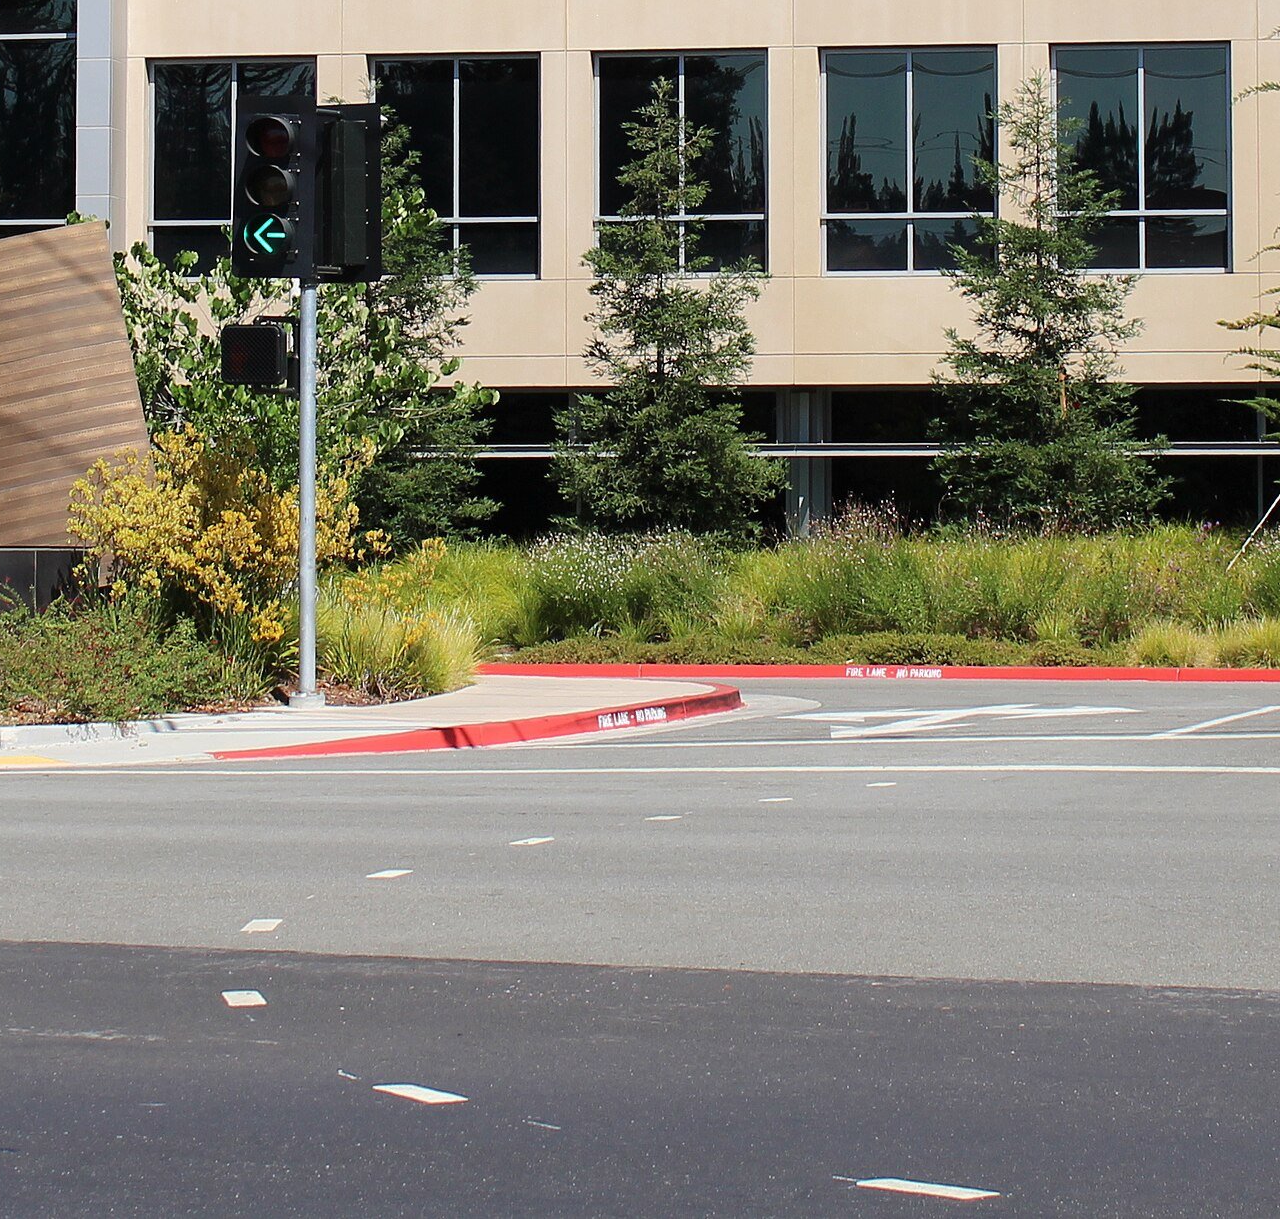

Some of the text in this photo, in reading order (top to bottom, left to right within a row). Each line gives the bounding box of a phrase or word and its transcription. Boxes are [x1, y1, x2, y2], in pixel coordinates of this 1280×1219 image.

[846, 667, 864, 677] FIRE
[866, 667, 887, 678] LANE
[896, 667, 908, 678] NO
[909, 668, 942, 678] PARKING
